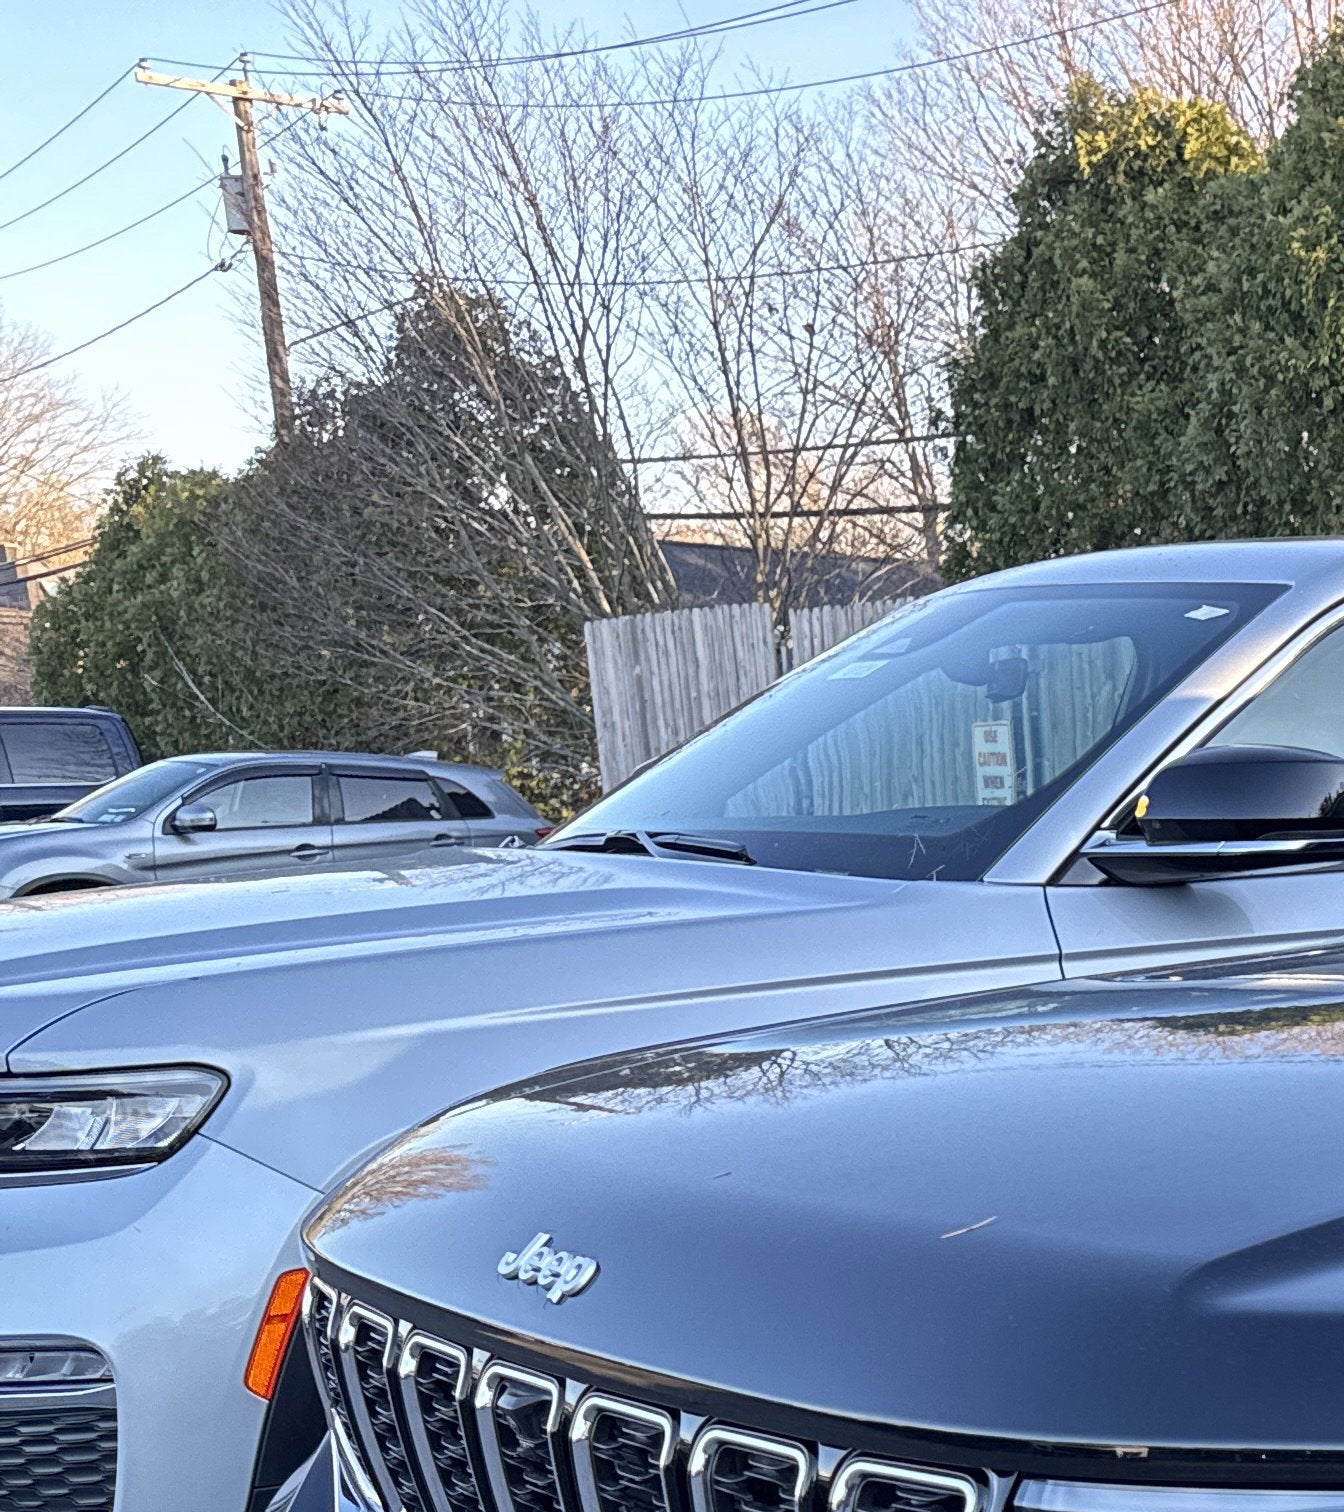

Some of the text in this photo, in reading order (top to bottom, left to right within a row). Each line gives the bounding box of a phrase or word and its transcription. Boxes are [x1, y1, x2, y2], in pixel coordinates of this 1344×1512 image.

[984, 730, 998, 744] USE
[978, 752, 1007, 767] CAUTION
[497, 1232, 600, 1304] Jeep
